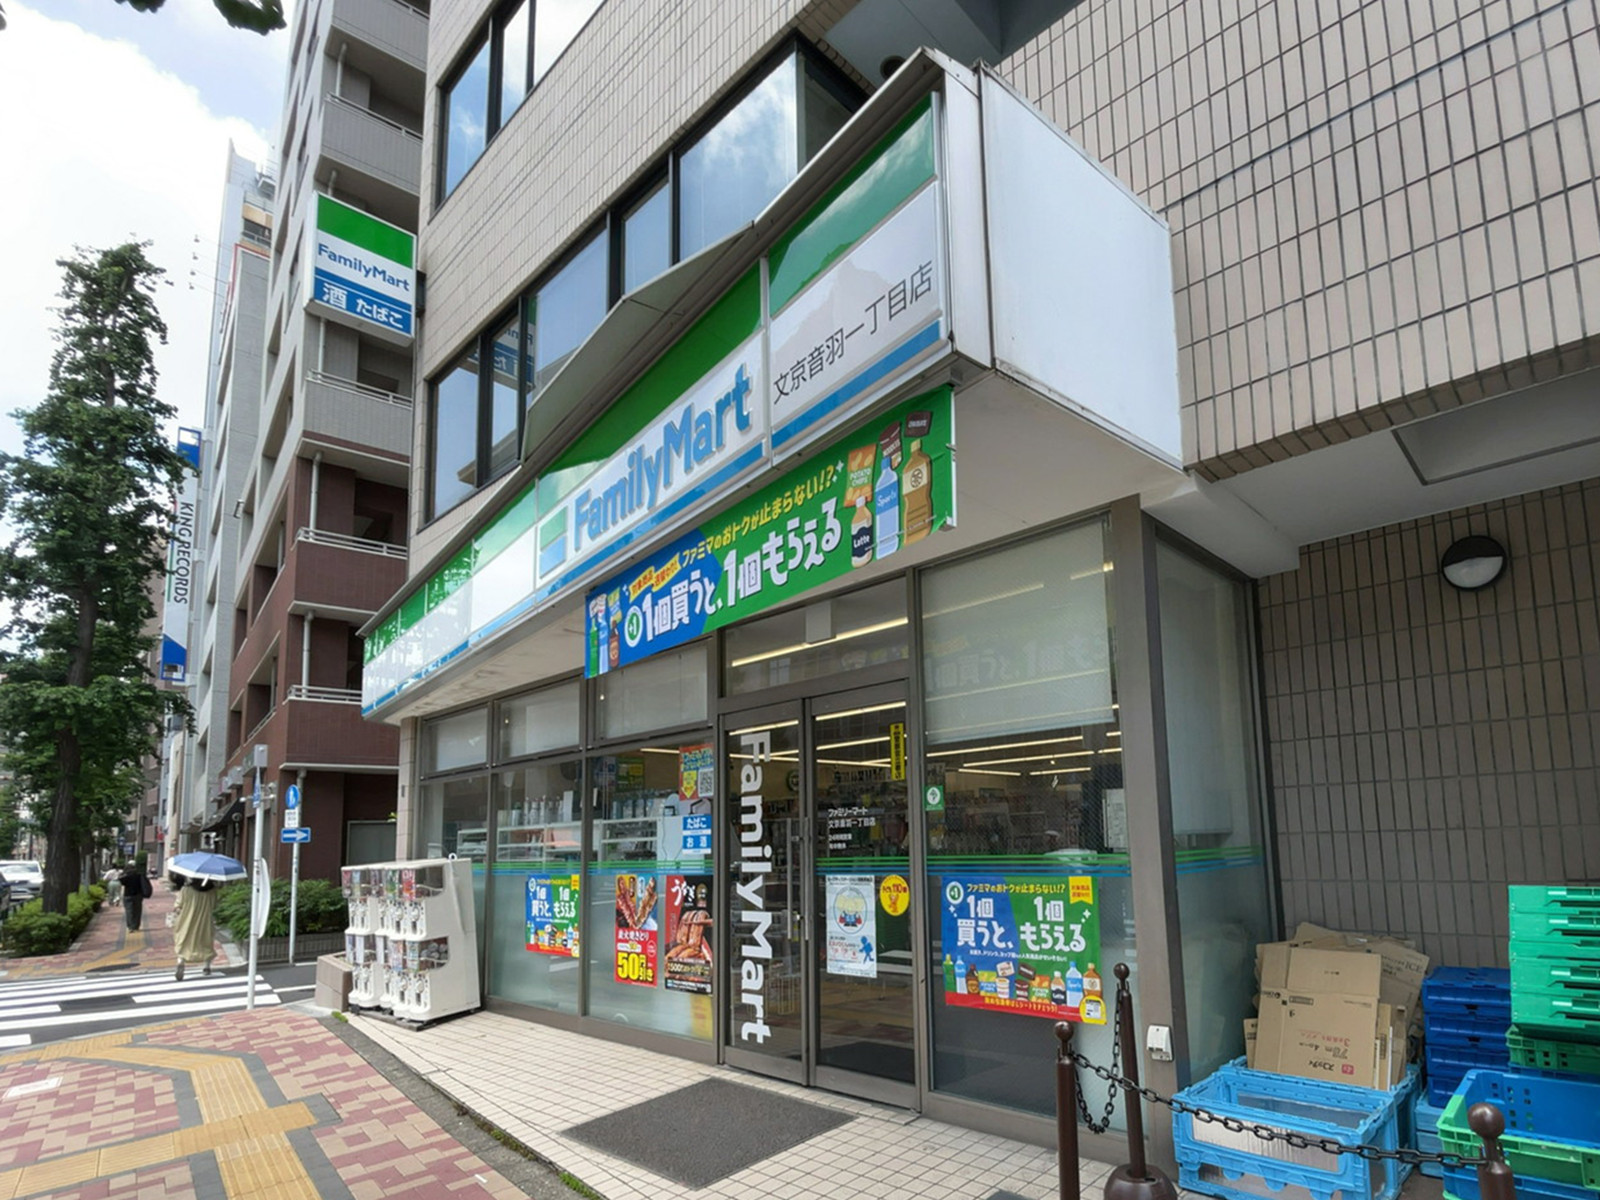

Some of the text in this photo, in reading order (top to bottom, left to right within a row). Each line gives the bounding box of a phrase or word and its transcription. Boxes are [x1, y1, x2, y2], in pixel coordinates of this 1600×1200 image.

[317, 243, 410, 292] FamilyMart
[322, 282, 404, 329] 酒 たばこ
[773, 260, 933, 405] 文京音羽一丁目店
[575, 362, 752, 551] FamilyMart
[174, 502, 194, 605] KING RECORDS
[853, 534, 871, 549] Latte
[686, 817, 708, 829] たばこ
[827, 806, 868, 818] ファミリーマート
[671, 878, 696, 906] うなぎ
[736, 730, 773, 1044] FamilyMart
[553, 900, 577, 918] もらえる
[966, 895, 1065, 922] 1個 1個
[956, 918, 1087, 952] 買うと、 もらえる
